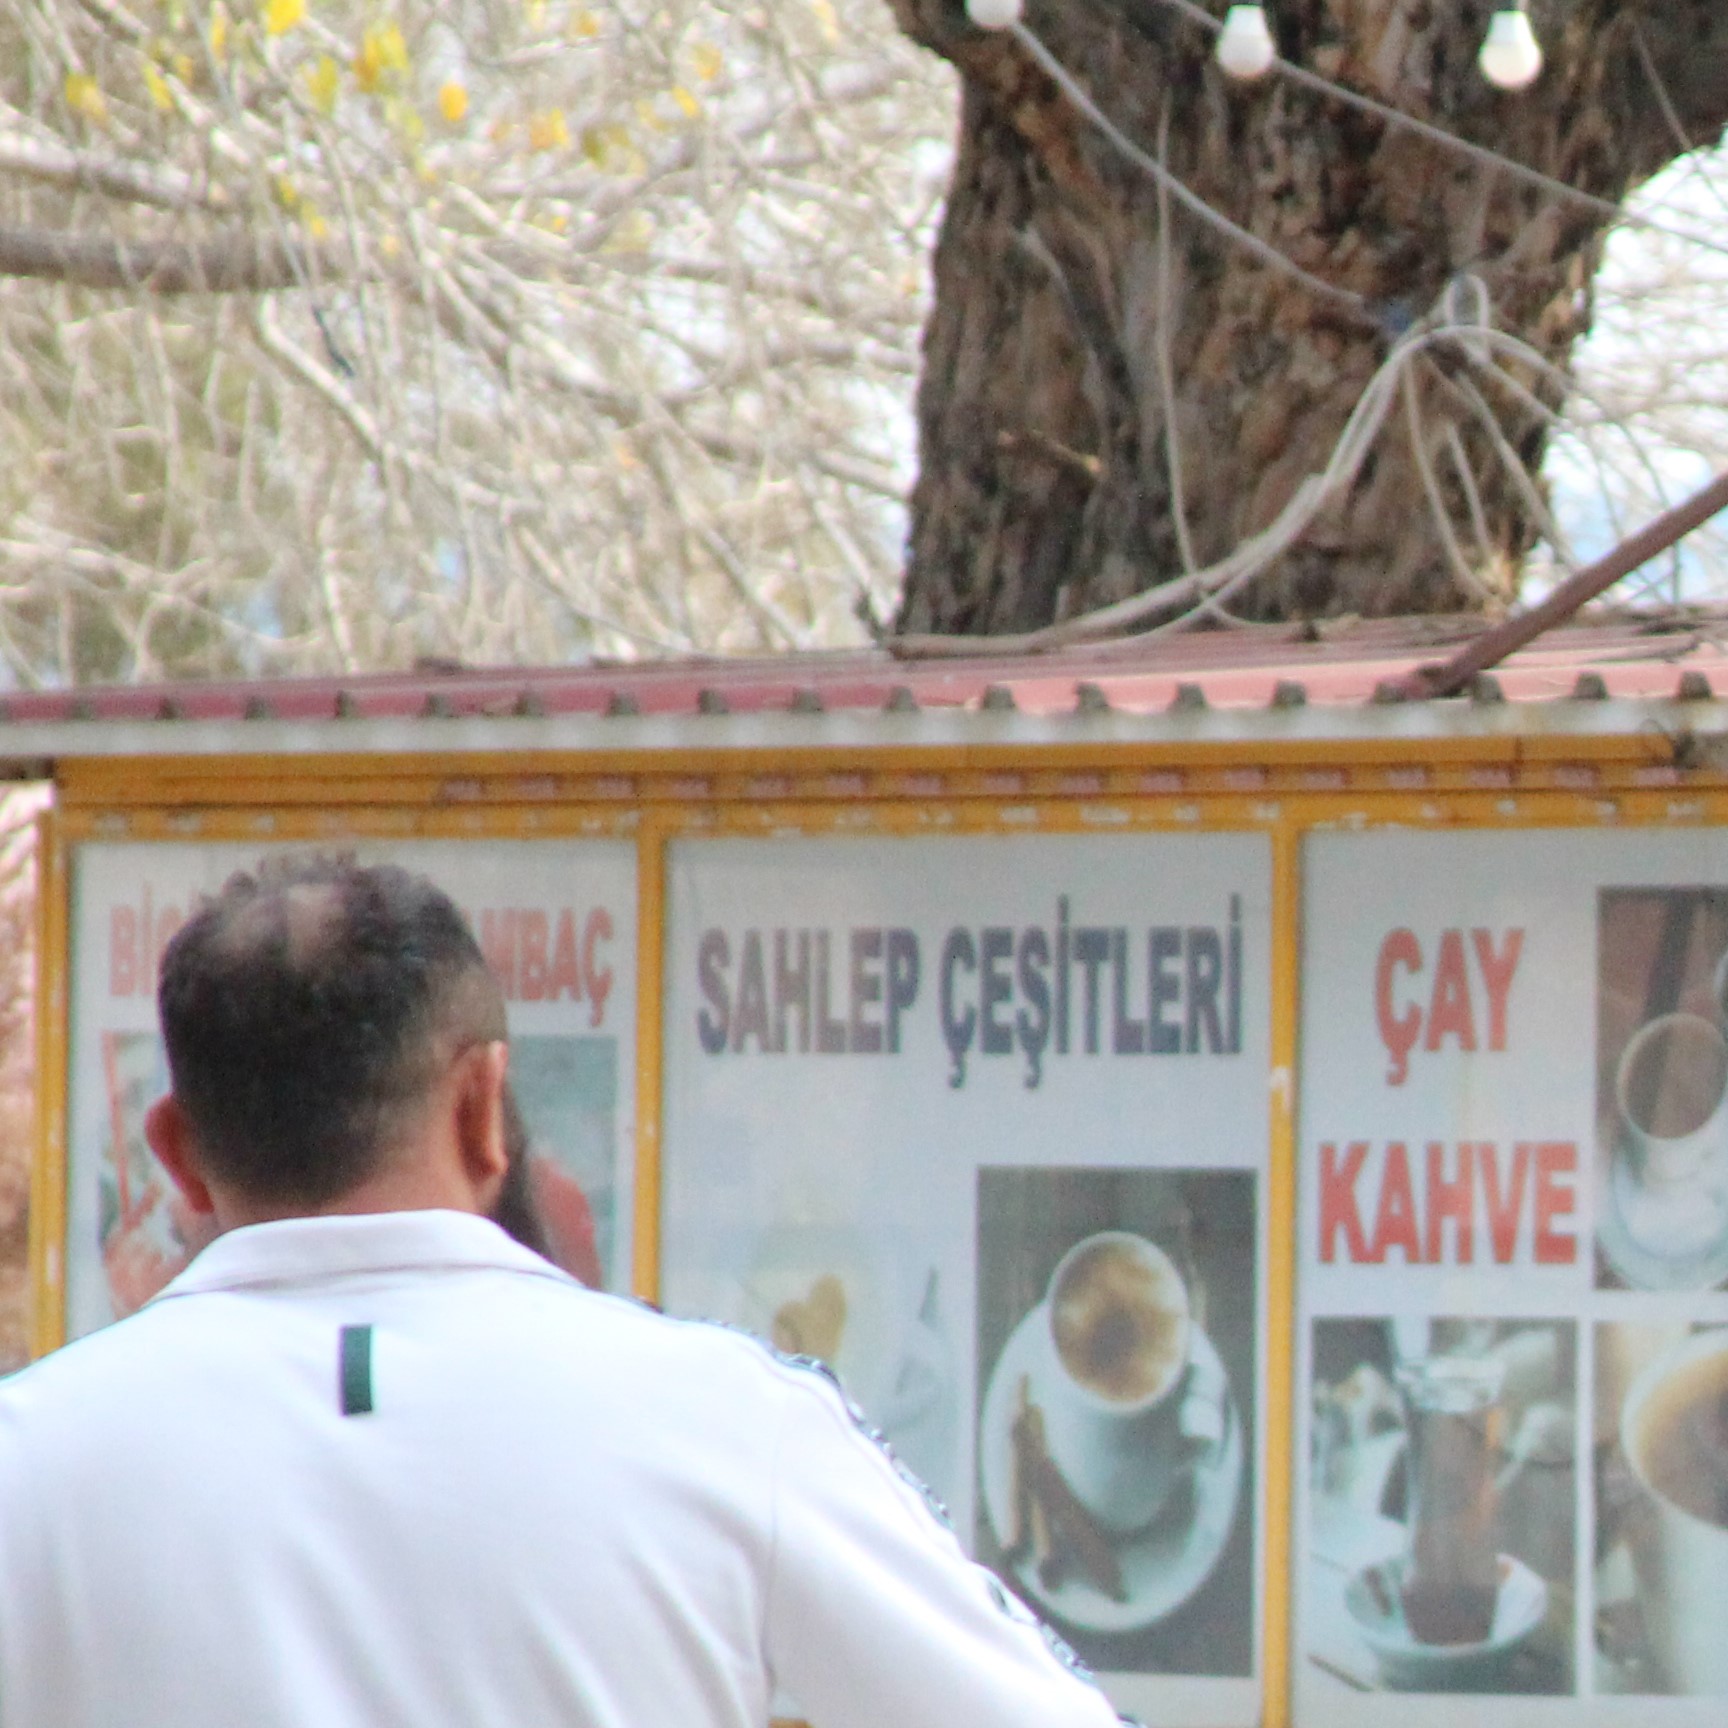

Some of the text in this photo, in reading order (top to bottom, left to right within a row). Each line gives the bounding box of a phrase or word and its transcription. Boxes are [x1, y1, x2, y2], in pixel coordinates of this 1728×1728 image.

[697, 893, 1243, 1090] SAHLEP ÇEŞİTLERİ
[1374, 926, 1526, 1086] ÇAY
[1318, 1140, 1578, 1264] KAHVE
